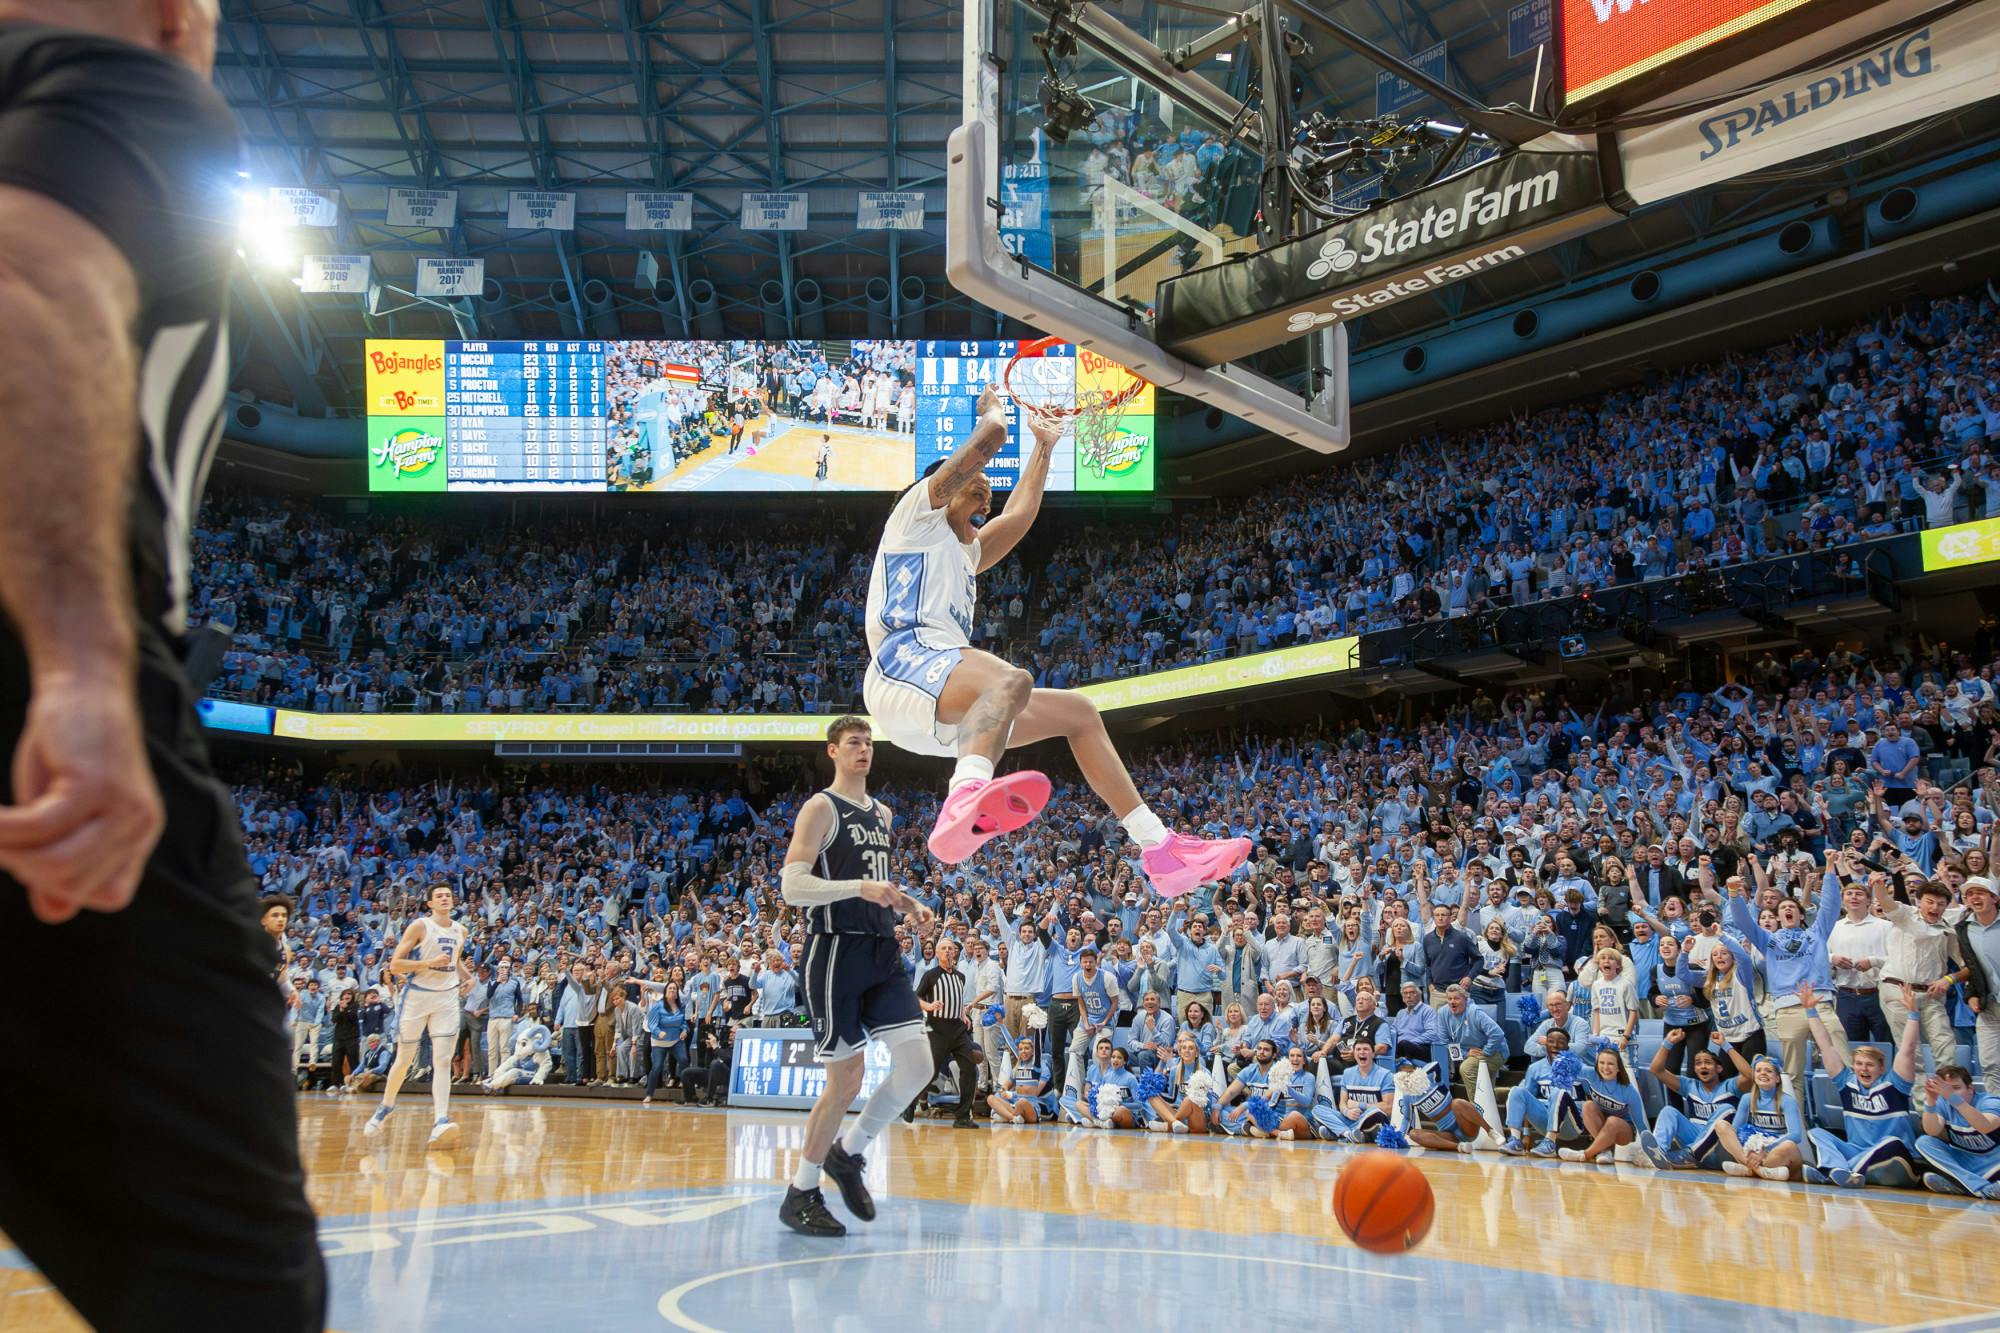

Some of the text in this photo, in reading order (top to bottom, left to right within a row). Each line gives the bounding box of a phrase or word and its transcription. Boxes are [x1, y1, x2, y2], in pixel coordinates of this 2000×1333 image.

[1700, 27, 1933, 161] SPALDING
[763, 210, 786, 220] 1994
[439, 275, 461, 285] 2017
[462, 342, 488, 352] PLAYER
[524, 343, 538, 352] PTS
[566, 343, 581, 352] AST
[588, 343, 601, 352] FLS
[960, 341, 979, 357] 9.3
[370, 351, 442, 374] Bojangles
[449, 354, 597, 366] 0 MCCAIN 23 11 1 1
[449, 366, 457, 378] 3
[523, 367, 539, 379] 20
[548, 367, 556, 379] 3
[569, 367, 577, 379] 2
[591, 367, 598, 379] 4
[966, 358, 990, 383] 84
[449, 379, 599, 391] 5 PROCTOR 2 3 2 3
[923, 384, 950, 396] FLS: 10
[393, 391, 415, 411] Bo
[446, 392, 599, 404] 25 MITCHELL 11 7 2 0
[447, 404, 599, 416] 30 FILIPOWSKI 22 5 0 4
[940, 397, 950, 413] 7
[450, 418, 458, 428] 3
[935, 417, 954, 432] 16
[461, 430, 487, 440] DAVIS
[371, 433, 443, 466] Hampton
[450, 442, 458, 453] 5
[935, 436, 953, 451] 12
[394, 450, 437, 478] Farms
[450, 455, 458, 466] 7
[995, 458, 1020, 468] POINTS
[447, 467, 462, 478] 55
[463, 467, 496, 479] INGRAM
[732, 718, 819, 738] partner
[862, 850, 889, 881] 30
[1601, 995, 1615, 1007] 23
[1718, 1000, 1730, 1017] 2
[762, 1042, 778, 1063] 84
[743, 1068, 772, 1081] FLS: 10
[744, 1081, 769, 1095] TOL: 1
